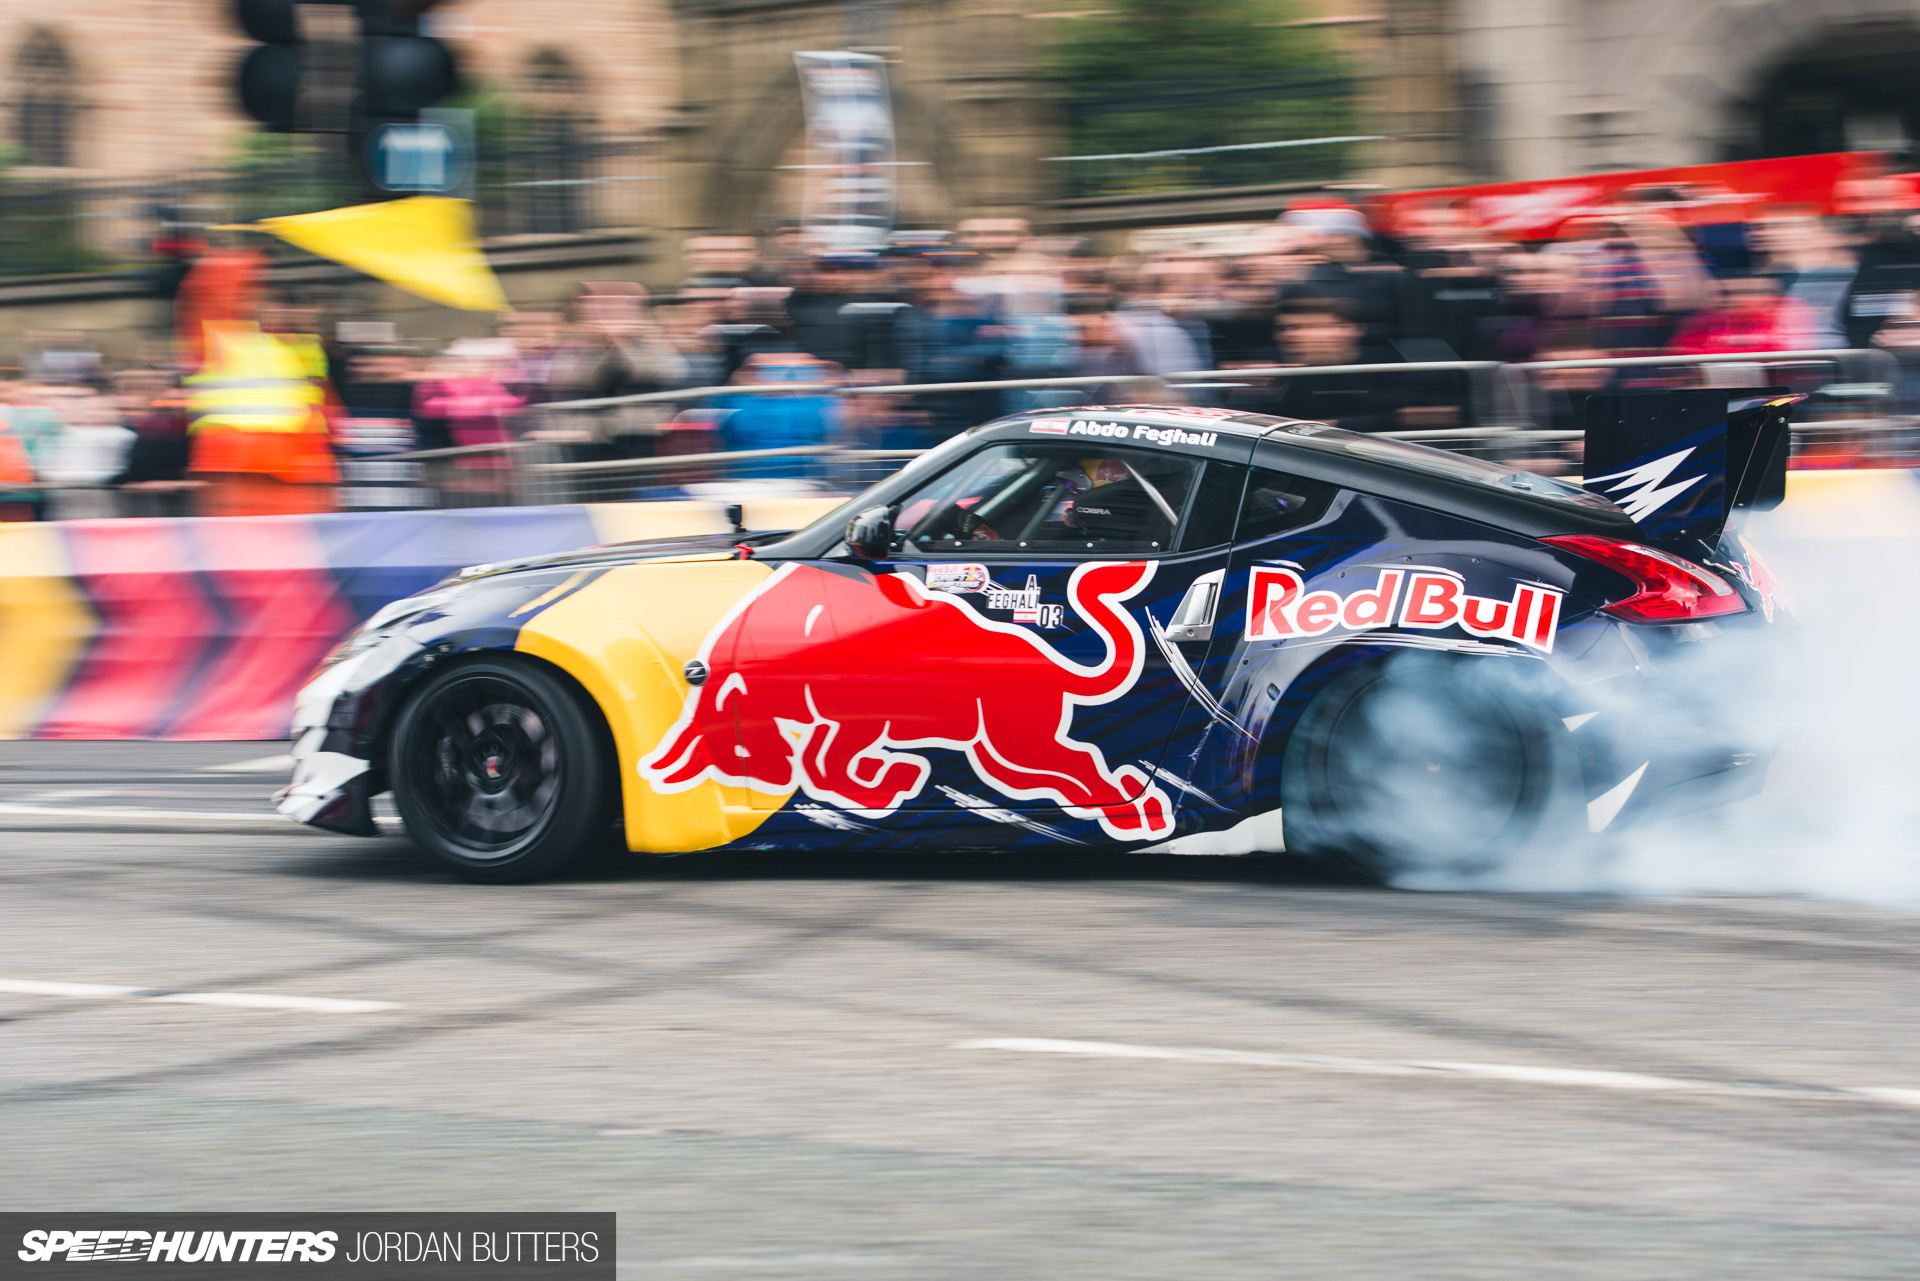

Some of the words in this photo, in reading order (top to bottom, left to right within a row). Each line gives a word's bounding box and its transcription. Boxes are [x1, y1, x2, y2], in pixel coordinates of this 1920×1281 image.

[1069, 420, 1129, 439] Abdo
[1132, 425, 1218, 447] Feghali
[988, 593, 1039, 609] FEGHALI
[1247, 568, 1403, 639] Red
[1401, 574, 1560, 651] Bull
[1040, 605, 1063, 628] 03
